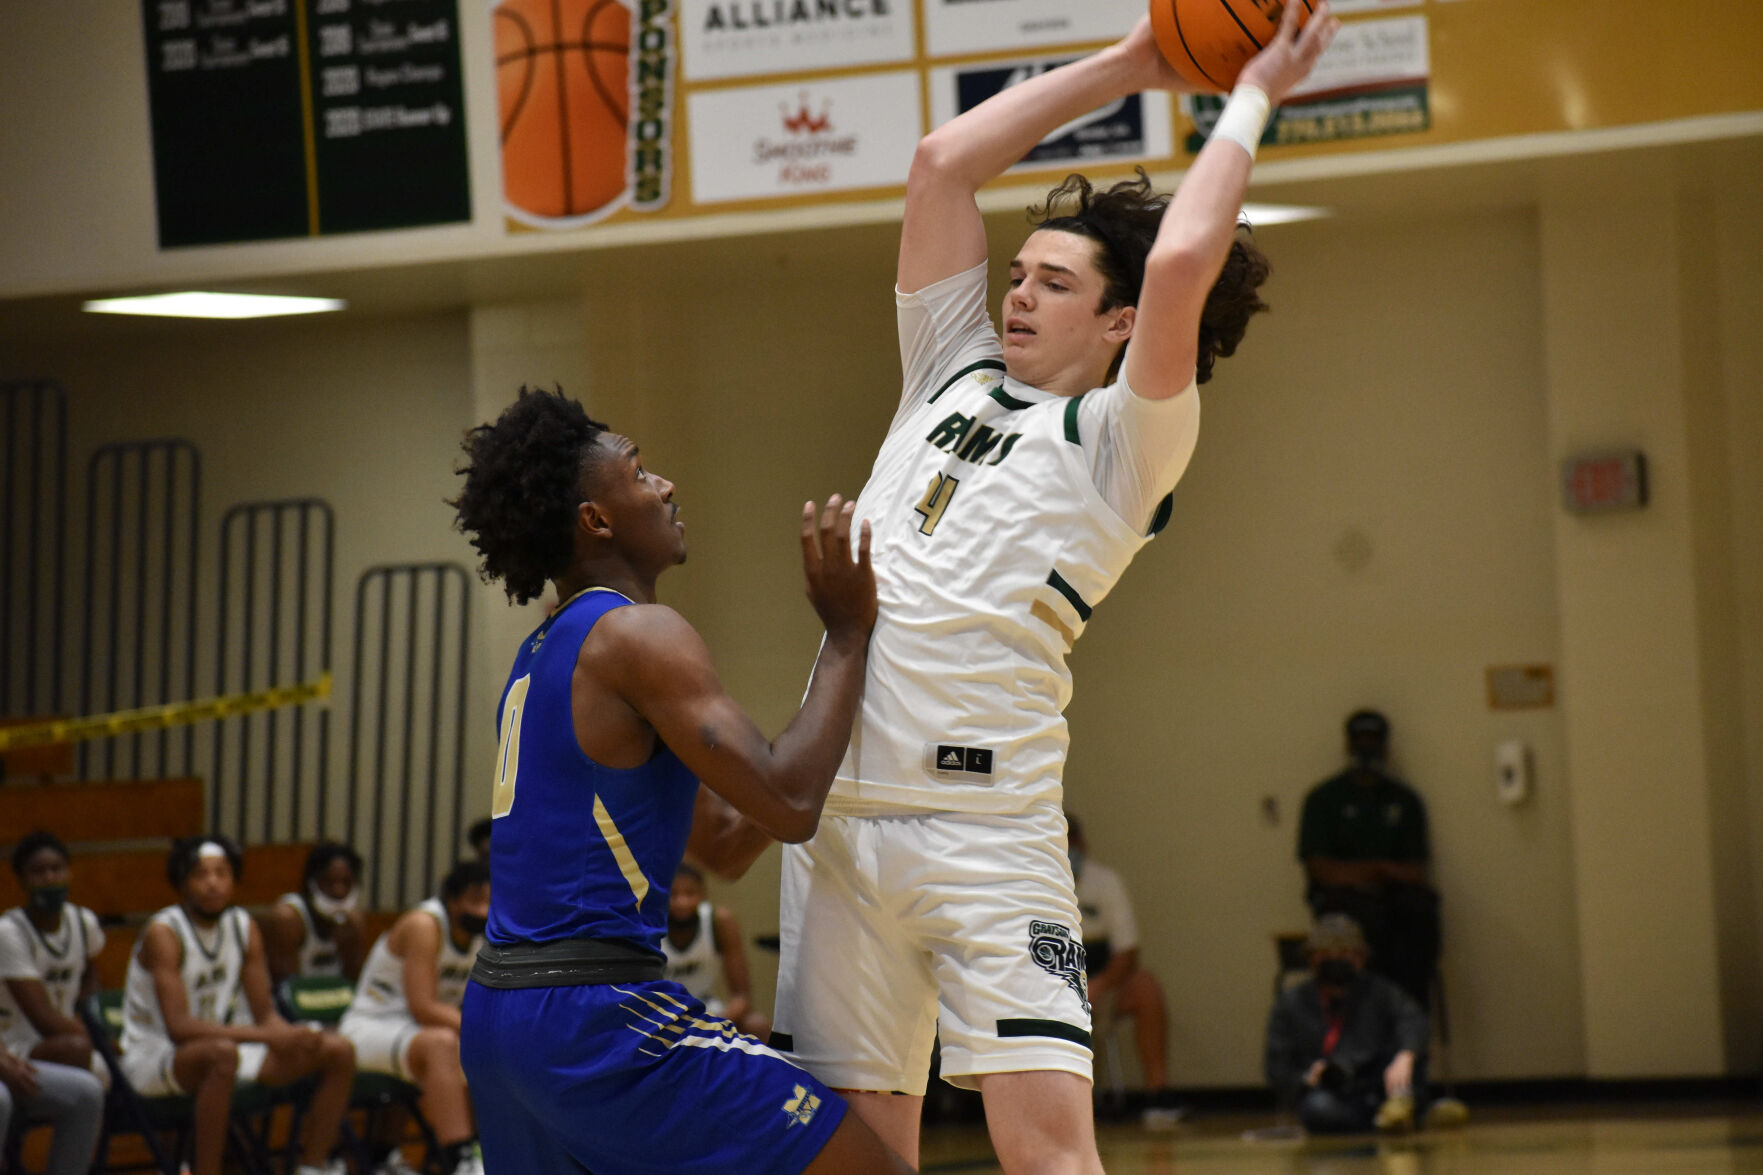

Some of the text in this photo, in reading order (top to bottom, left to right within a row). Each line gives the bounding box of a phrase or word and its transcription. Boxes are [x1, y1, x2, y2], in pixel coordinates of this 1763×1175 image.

[703, 0, 892, 31] ALLIANCE
[926, 411, 1024, 466] RAMS
[914, 471, 960, 536] 4
[492, 672, 530, 820] 0
